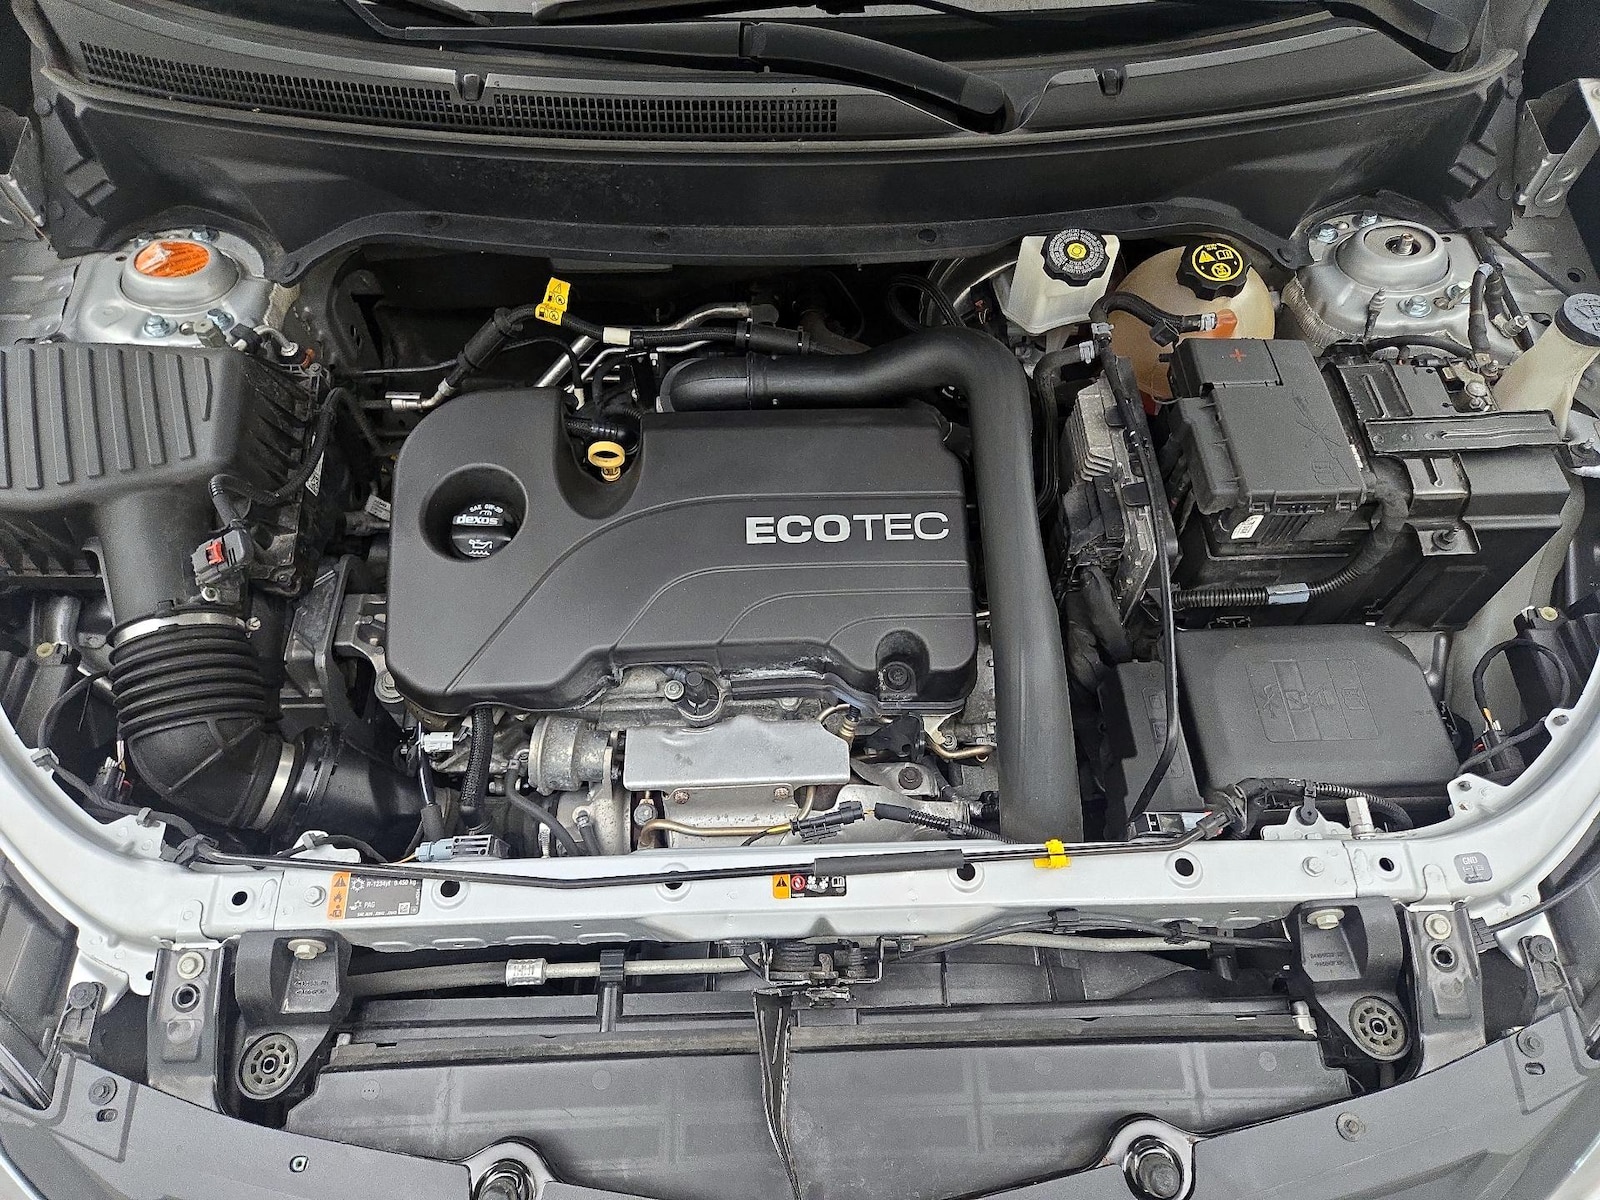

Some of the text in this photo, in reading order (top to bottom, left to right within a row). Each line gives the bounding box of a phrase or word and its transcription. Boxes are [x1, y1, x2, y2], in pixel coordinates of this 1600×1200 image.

[456, 514, 499, 525] dexos
[745, 511, 949, 544] ECOTEC
[1462, 856, 1478, 865] GND
[363, 901, 376, 909] PAG
